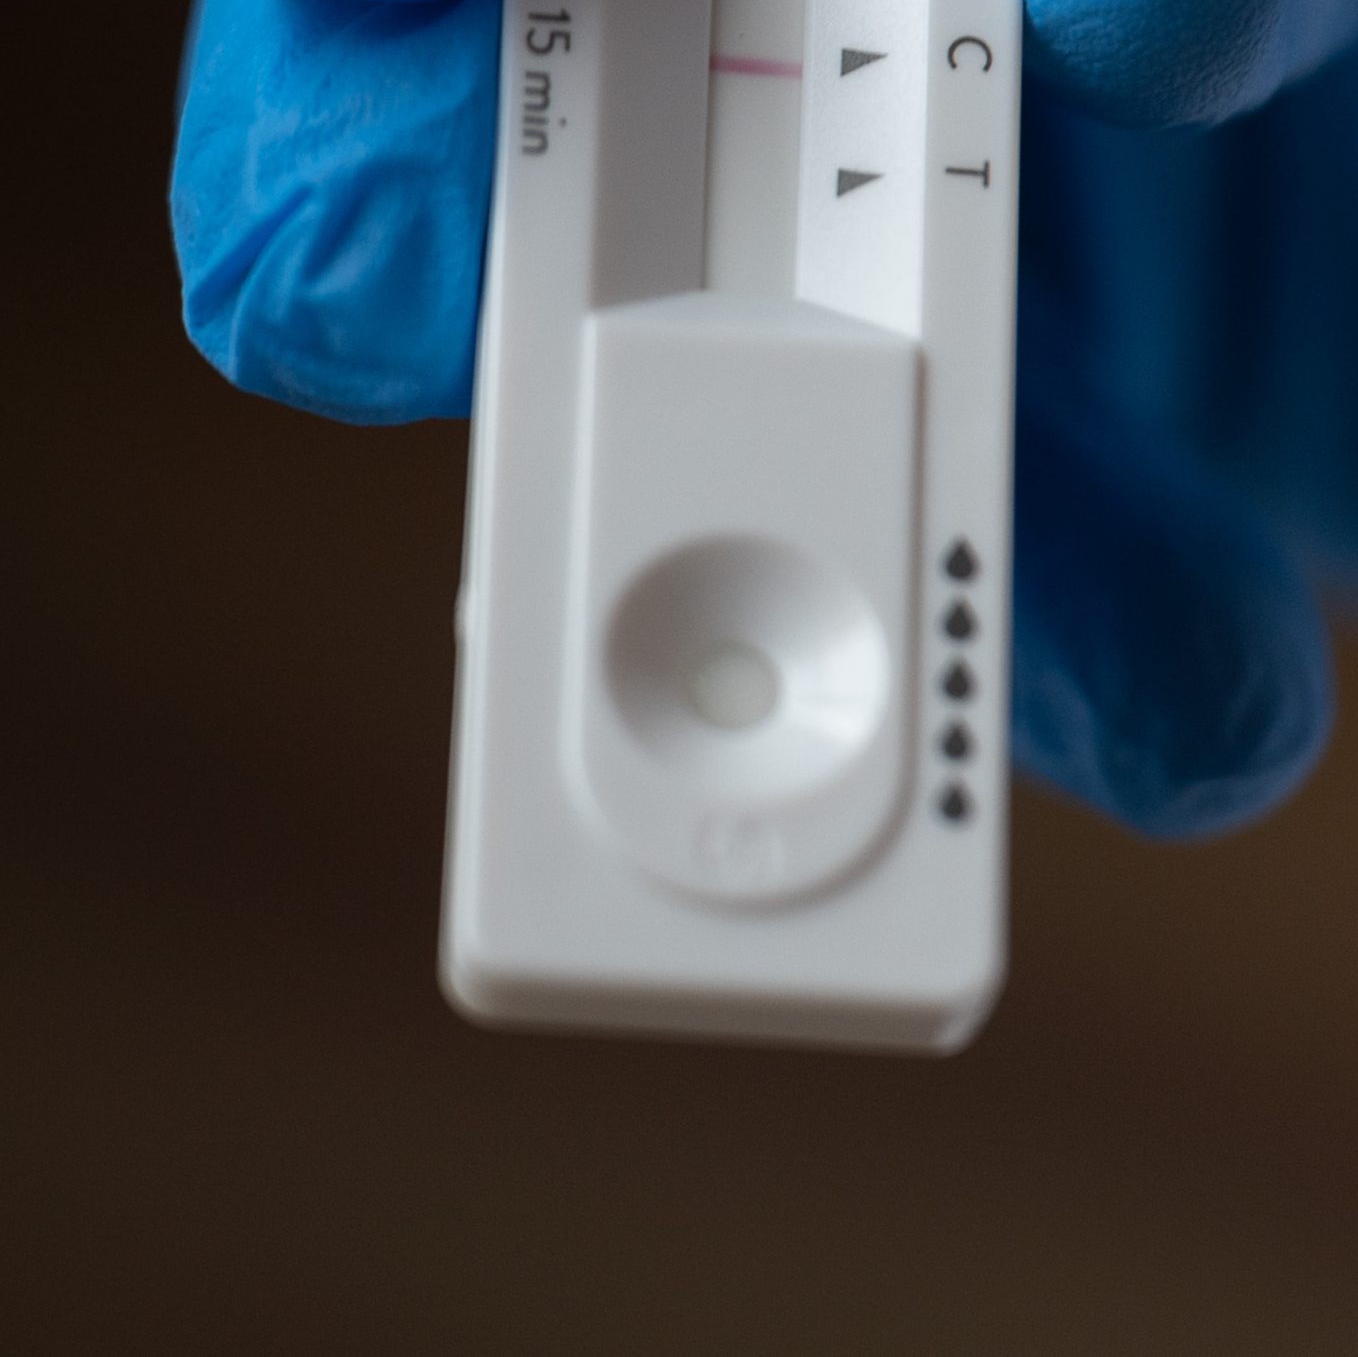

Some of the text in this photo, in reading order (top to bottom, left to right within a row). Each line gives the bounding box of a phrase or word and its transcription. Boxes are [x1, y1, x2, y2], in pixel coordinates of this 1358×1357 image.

[947, 35, 993, 72] C
[522, 8, 572, 156] 15 min
[944, 160, 990, 189] T
